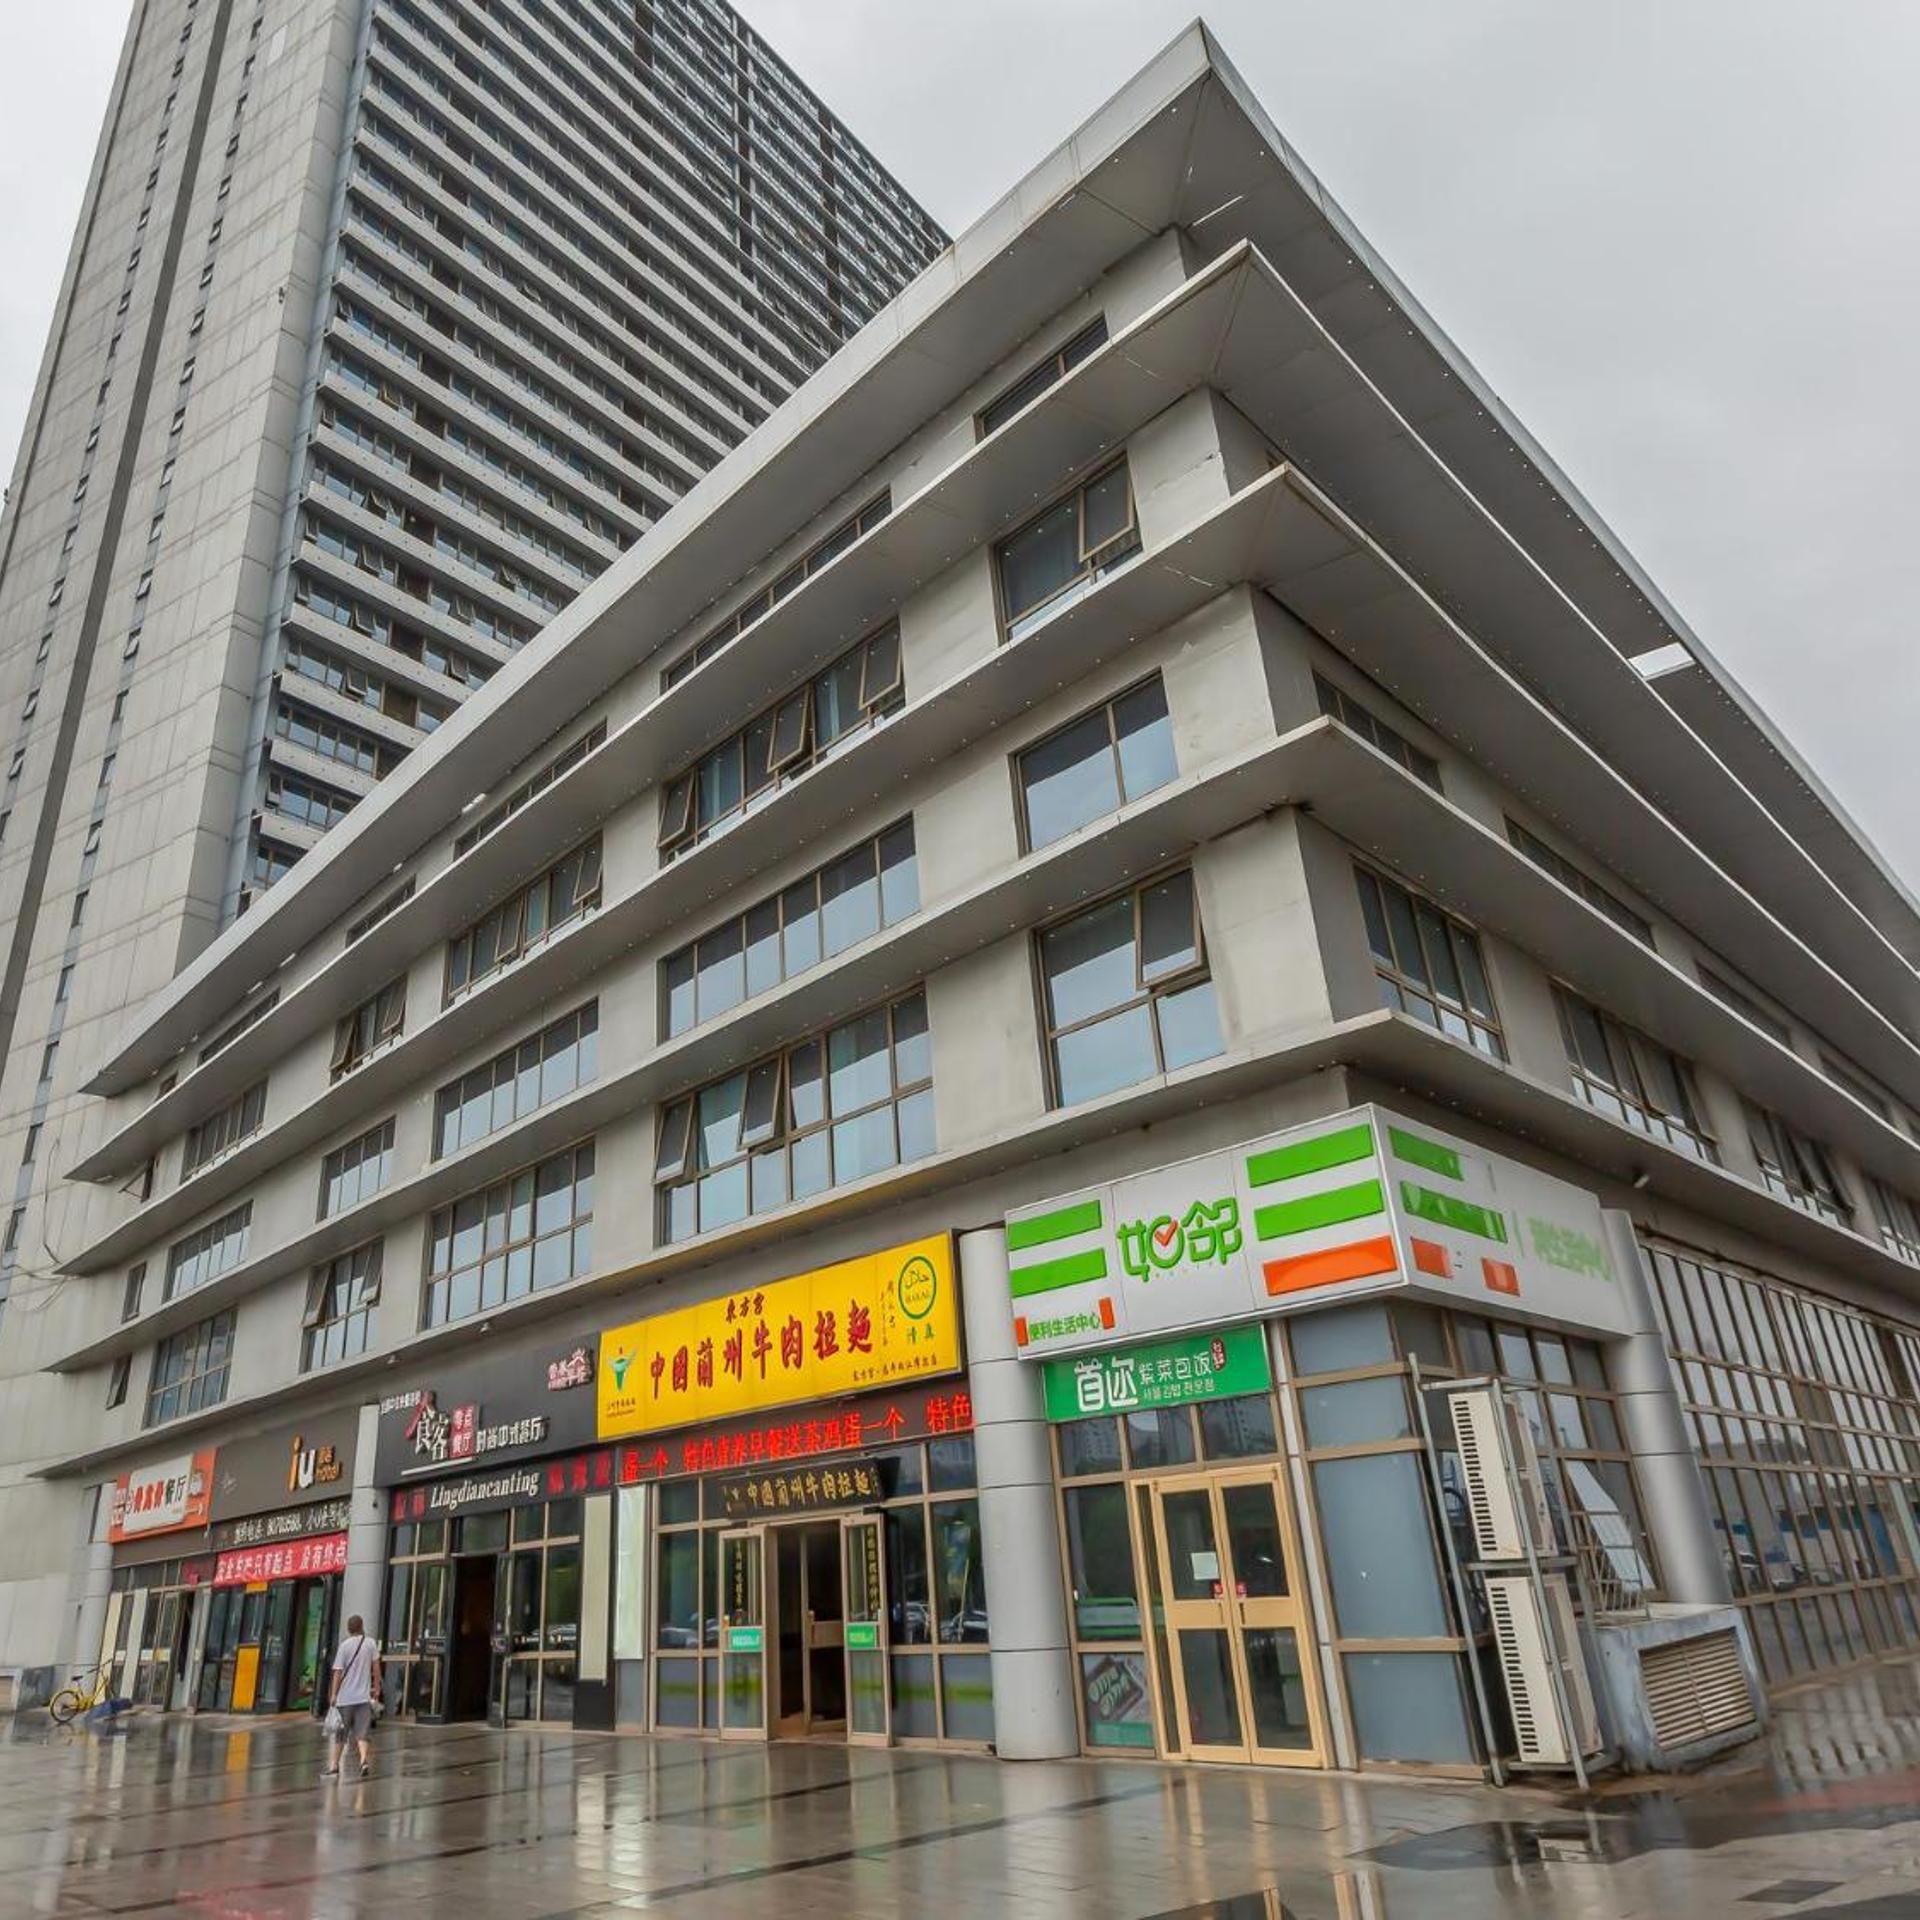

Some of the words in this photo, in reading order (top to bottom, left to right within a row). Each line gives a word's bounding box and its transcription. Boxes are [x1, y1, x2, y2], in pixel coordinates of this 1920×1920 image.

[1029, 1312, 1101, 1341] 便利生活中心
[1138, 1351, 1212, 1386] 紫菜包饭
[926, 1391, 974, 1435] 特色
[430, 1469, 540, 1511] Lingdiancanting
